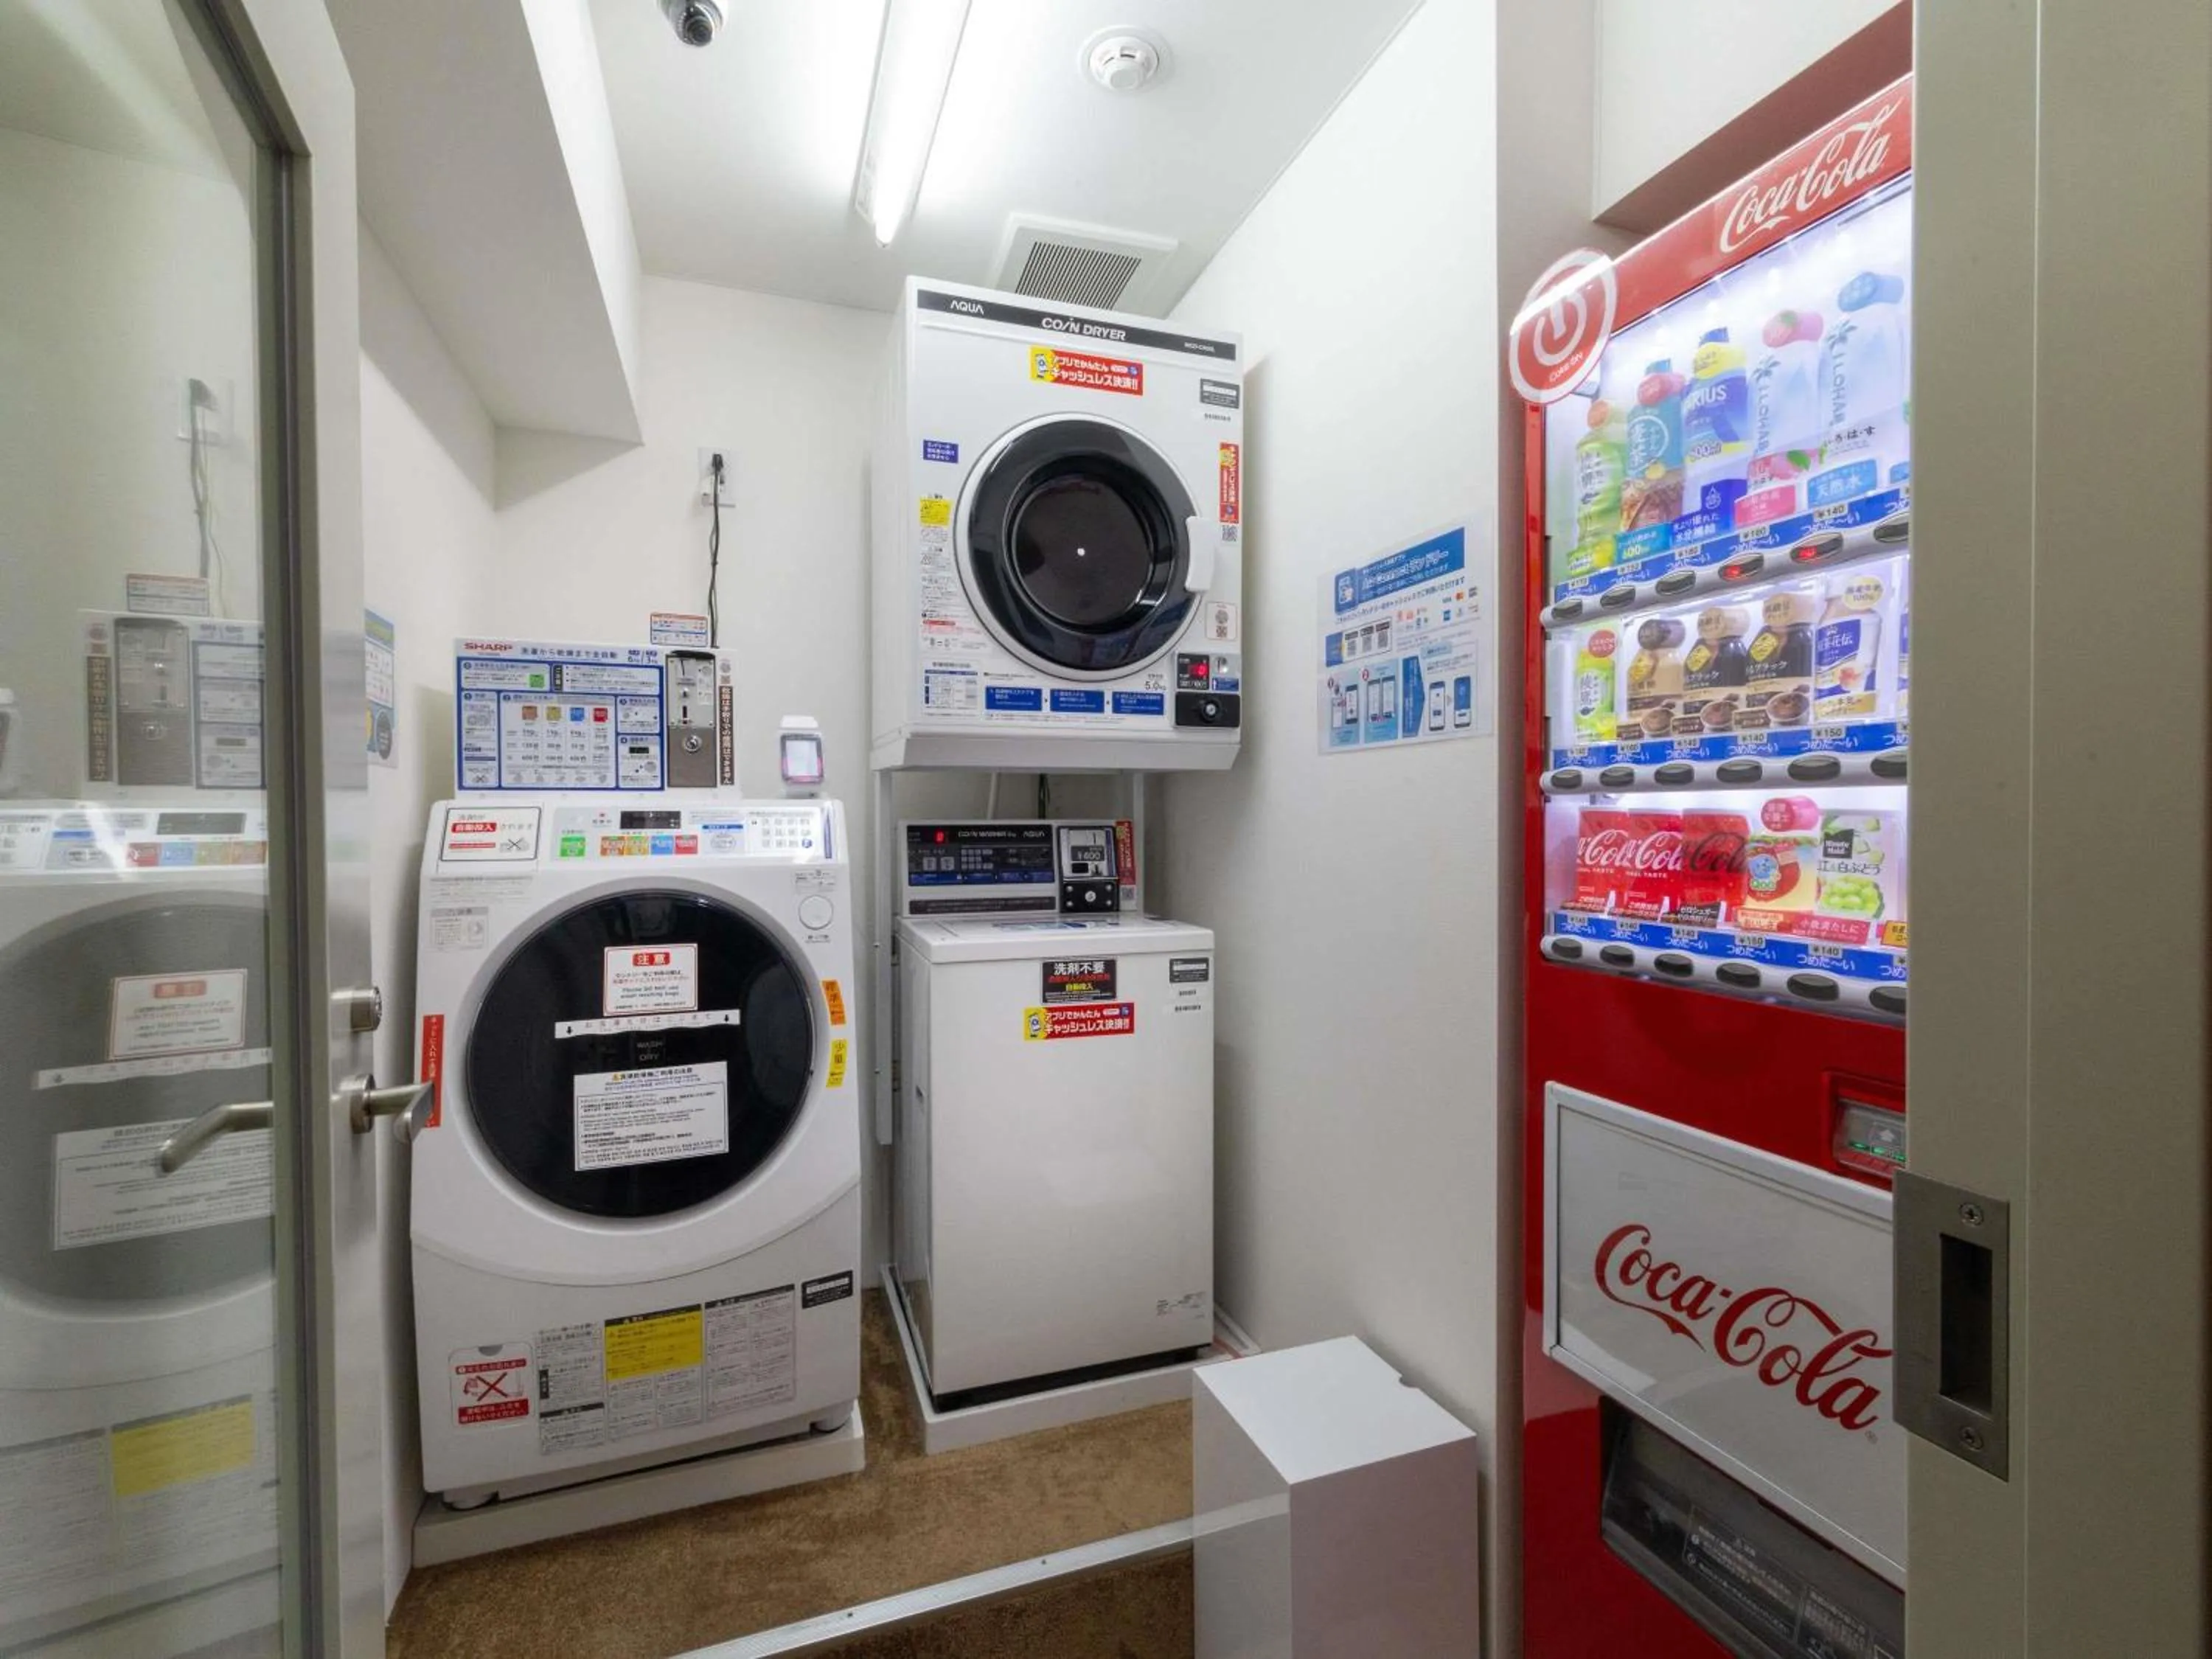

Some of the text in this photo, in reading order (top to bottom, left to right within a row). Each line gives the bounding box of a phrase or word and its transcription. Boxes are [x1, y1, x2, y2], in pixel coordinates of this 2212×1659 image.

[1719, 98, 1904, 254] Coca-Cola
[950, 299, 984, 315] AQUA
[1041, 317, 1127, 341] COIN DRYER
[463, 641, 514, 654] SHARP
[1054, 961, 1105, 975] 洗剤不要
[1595, 1224, 1893, 1431] Coca-Cola
